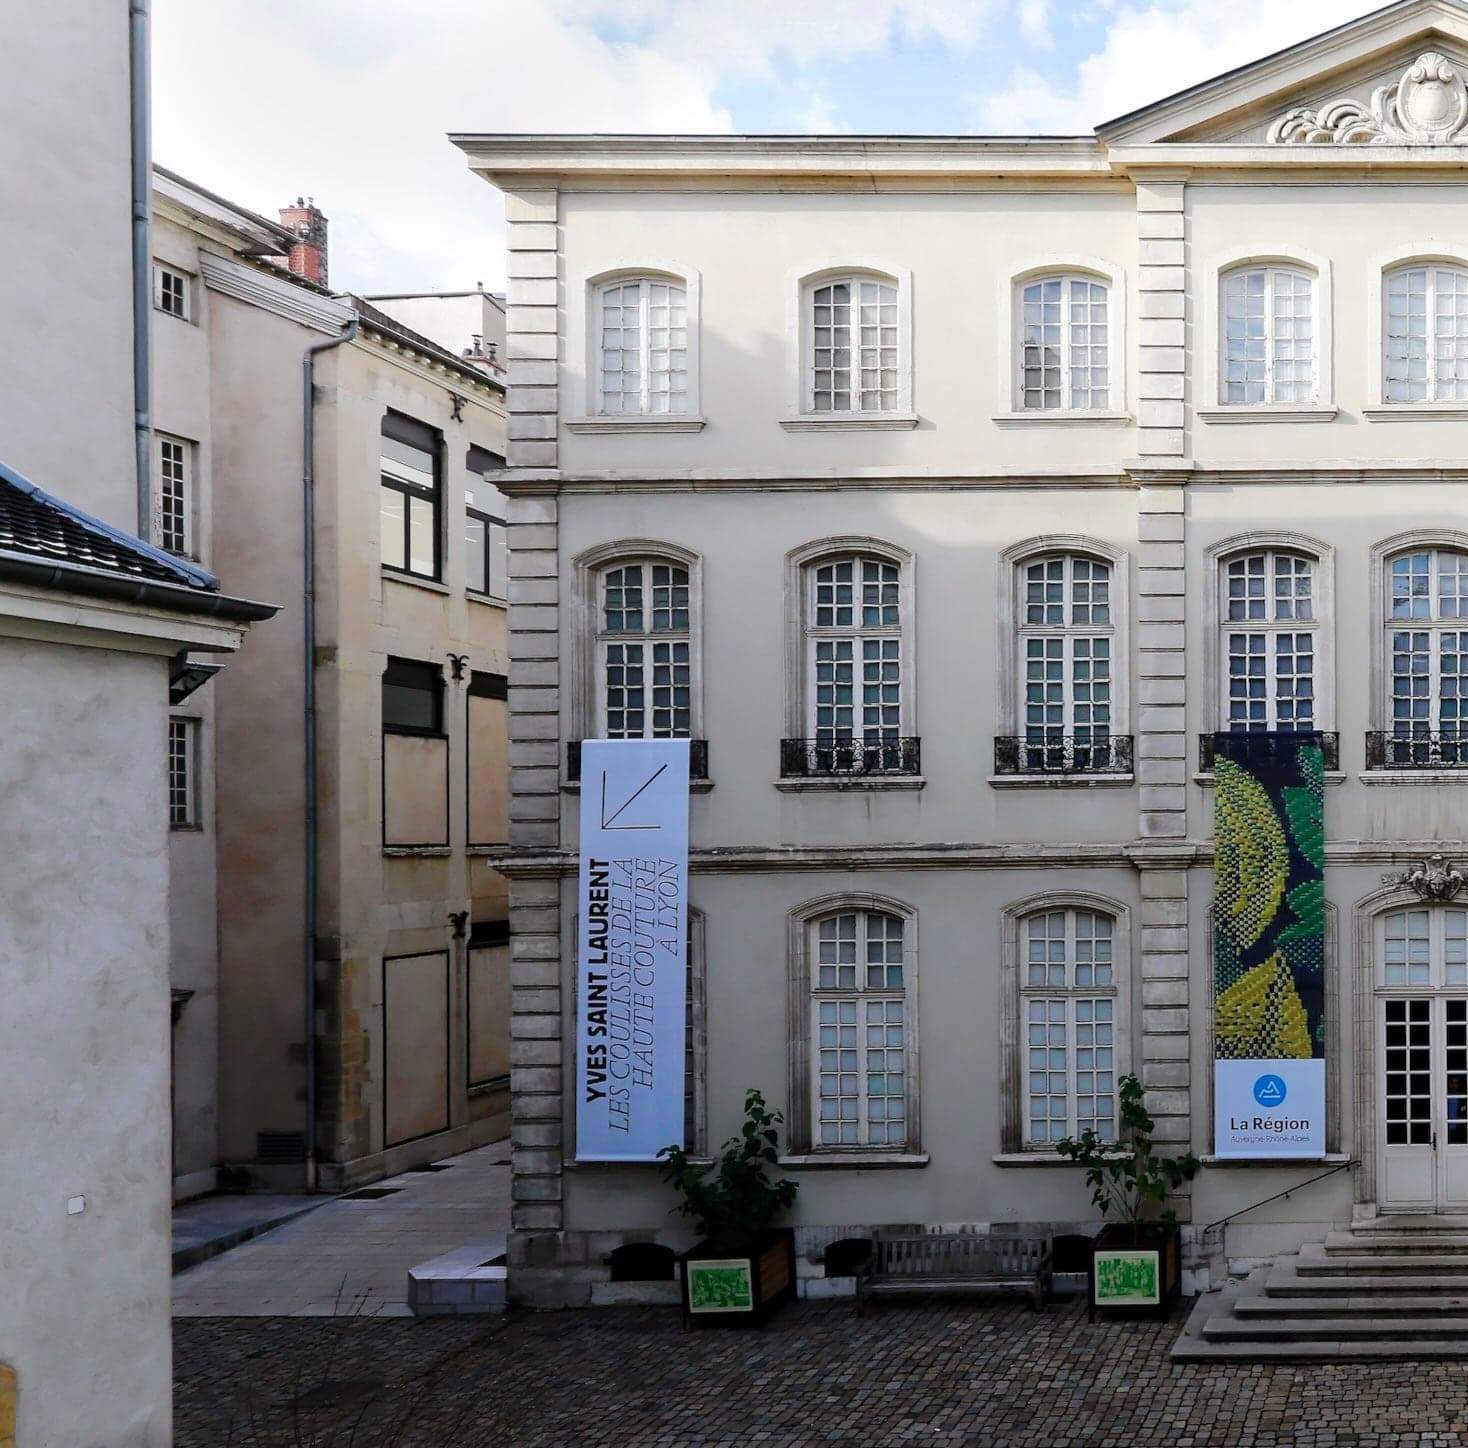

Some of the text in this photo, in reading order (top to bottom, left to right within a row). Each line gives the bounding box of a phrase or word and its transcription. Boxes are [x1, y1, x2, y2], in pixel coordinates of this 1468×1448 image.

[586, 859, 609, 1103] YVES SAINT LAURENT
[609, 857, 633, 1134] LES COULISSES DE LA
[633, 858, 655, 1089] HAUTE COUTURE
[654, 859, 679, 956] À LYON
[1231, 1117, 1309, 1132] La Région
